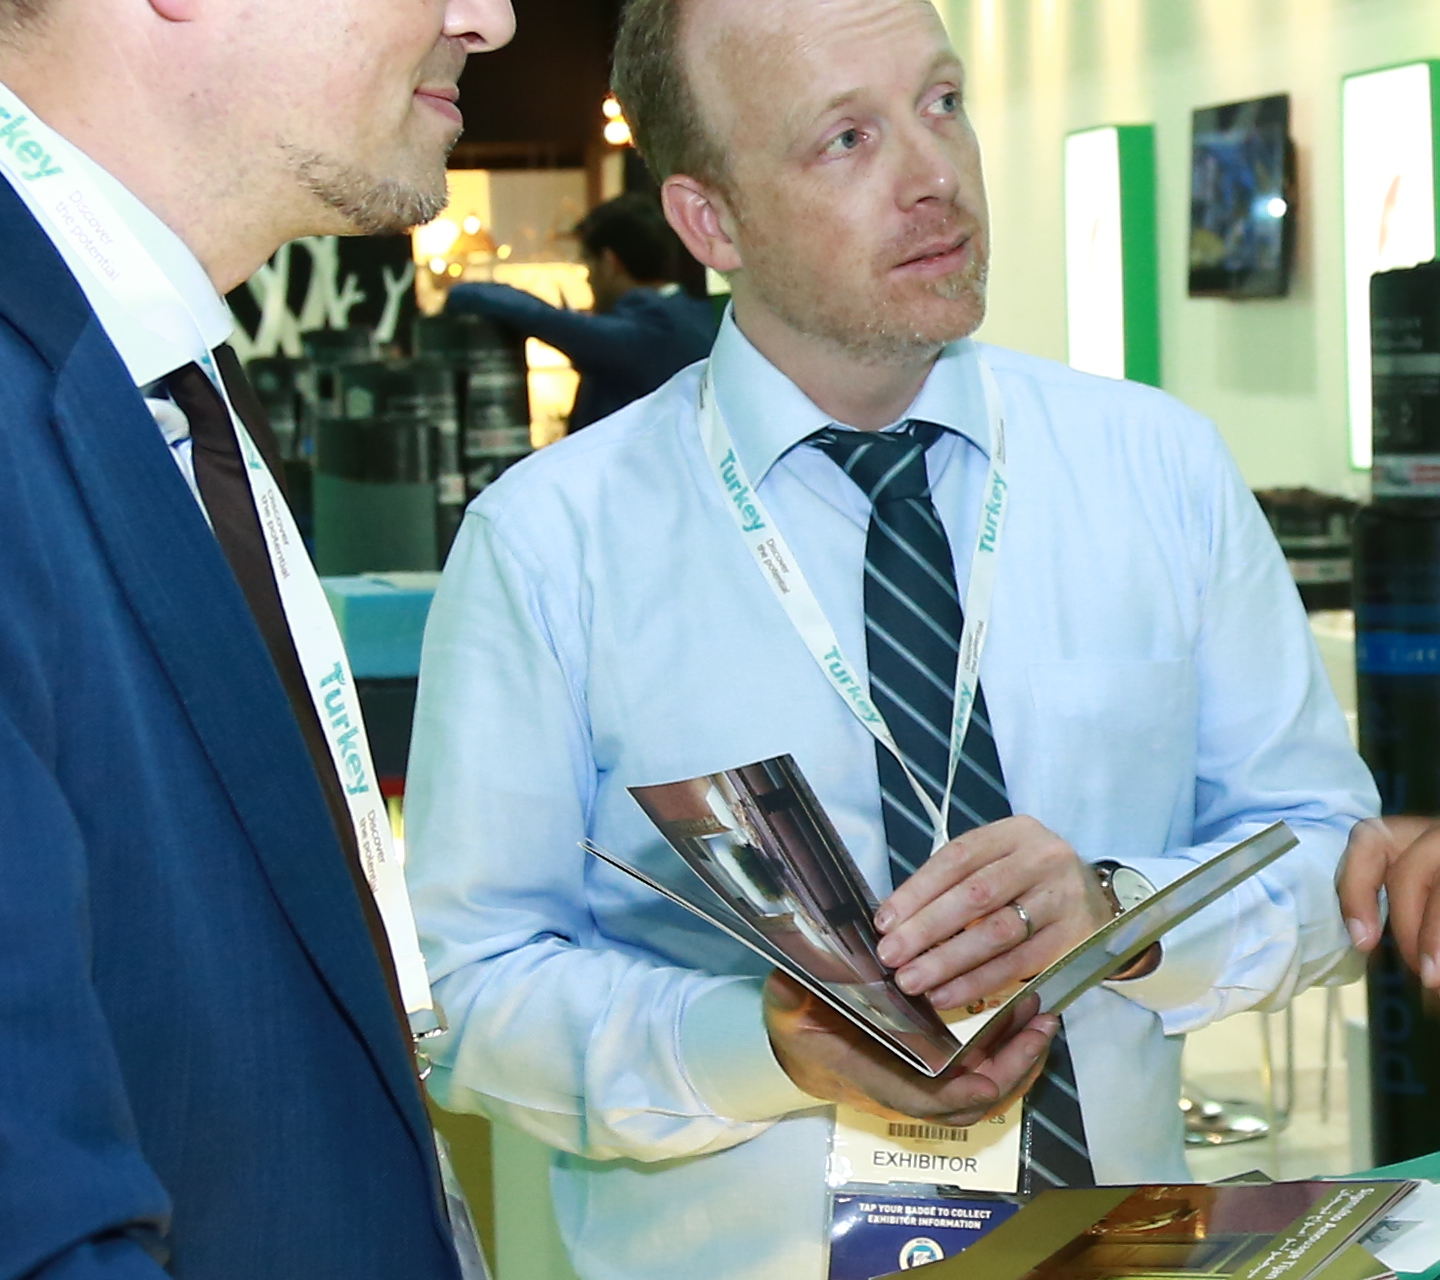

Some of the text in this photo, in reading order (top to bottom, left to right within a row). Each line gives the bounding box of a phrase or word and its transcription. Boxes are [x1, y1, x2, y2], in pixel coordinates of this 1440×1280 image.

[55, 200, 122, 282] the potential
[68, 189, 115, 246] Discover
[720, 447, 767, 533] Turkey
[979, 470, 1007, 554] Turkey
[757, 543, 790, 595] the potential
[765, 537, 790, 574] Discover
[823, 644, 882, 725] Turkey
[320, 661, 370, 796] Turkey
[367, 808, 386, 865] Discover
[872, 1150, 978, 1173] EXHIBITOR
[859, 1202, 992, 1220] TAP YOUR BADGE TO COLLECT
[867, 1215, 982, 1230] EXHIBITOR INFORMATION
